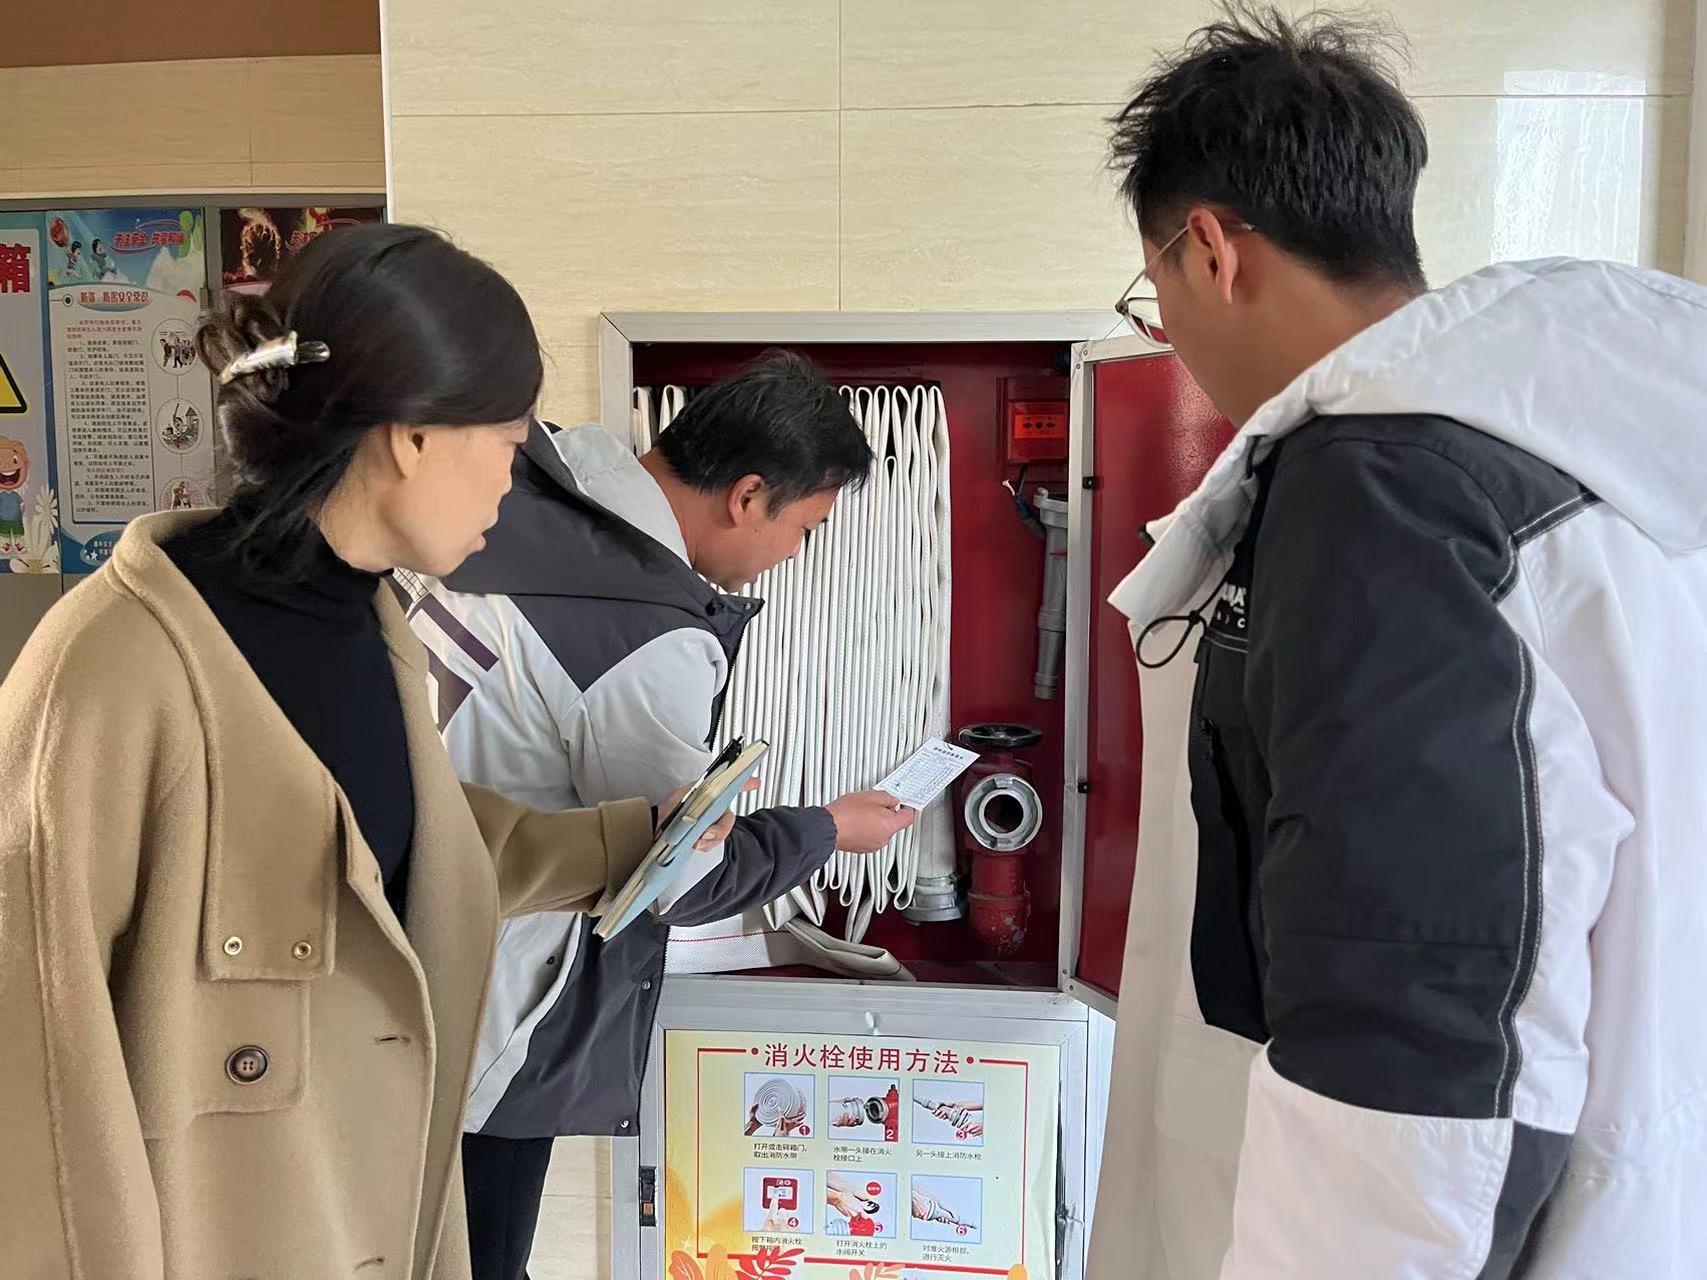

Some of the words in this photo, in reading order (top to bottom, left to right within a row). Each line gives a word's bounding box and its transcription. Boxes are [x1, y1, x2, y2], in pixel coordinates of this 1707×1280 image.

[0, 243, 31, 293] 箱
[764, 1043, 960, 1075] 消火栓使用方法
[885, 1129, 895, 1140] 2
